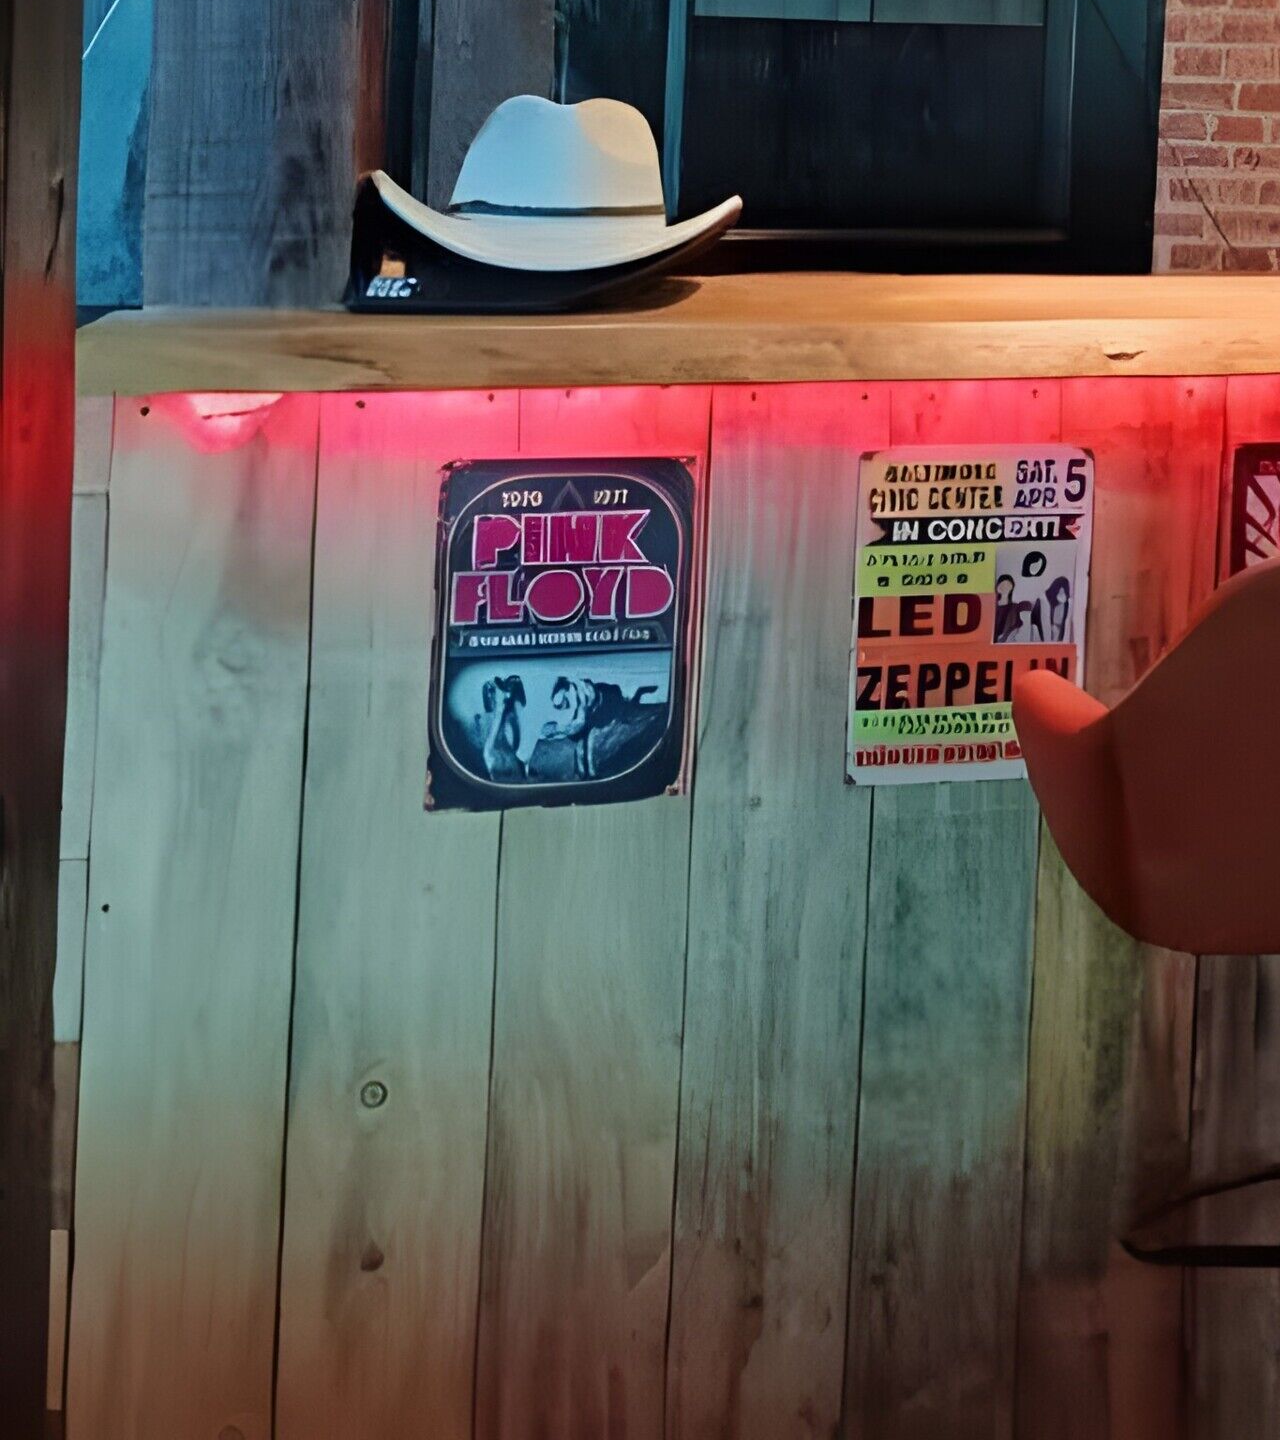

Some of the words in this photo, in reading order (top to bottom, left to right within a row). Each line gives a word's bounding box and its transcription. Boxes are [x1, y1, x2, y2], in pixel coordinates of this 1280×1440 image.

[1064, 459, 1086, 502] 5
[472, 509, 651, 570] PINK
[451, 565, 675, 626] FLOYD
[858, 593, 982, 639] LED
